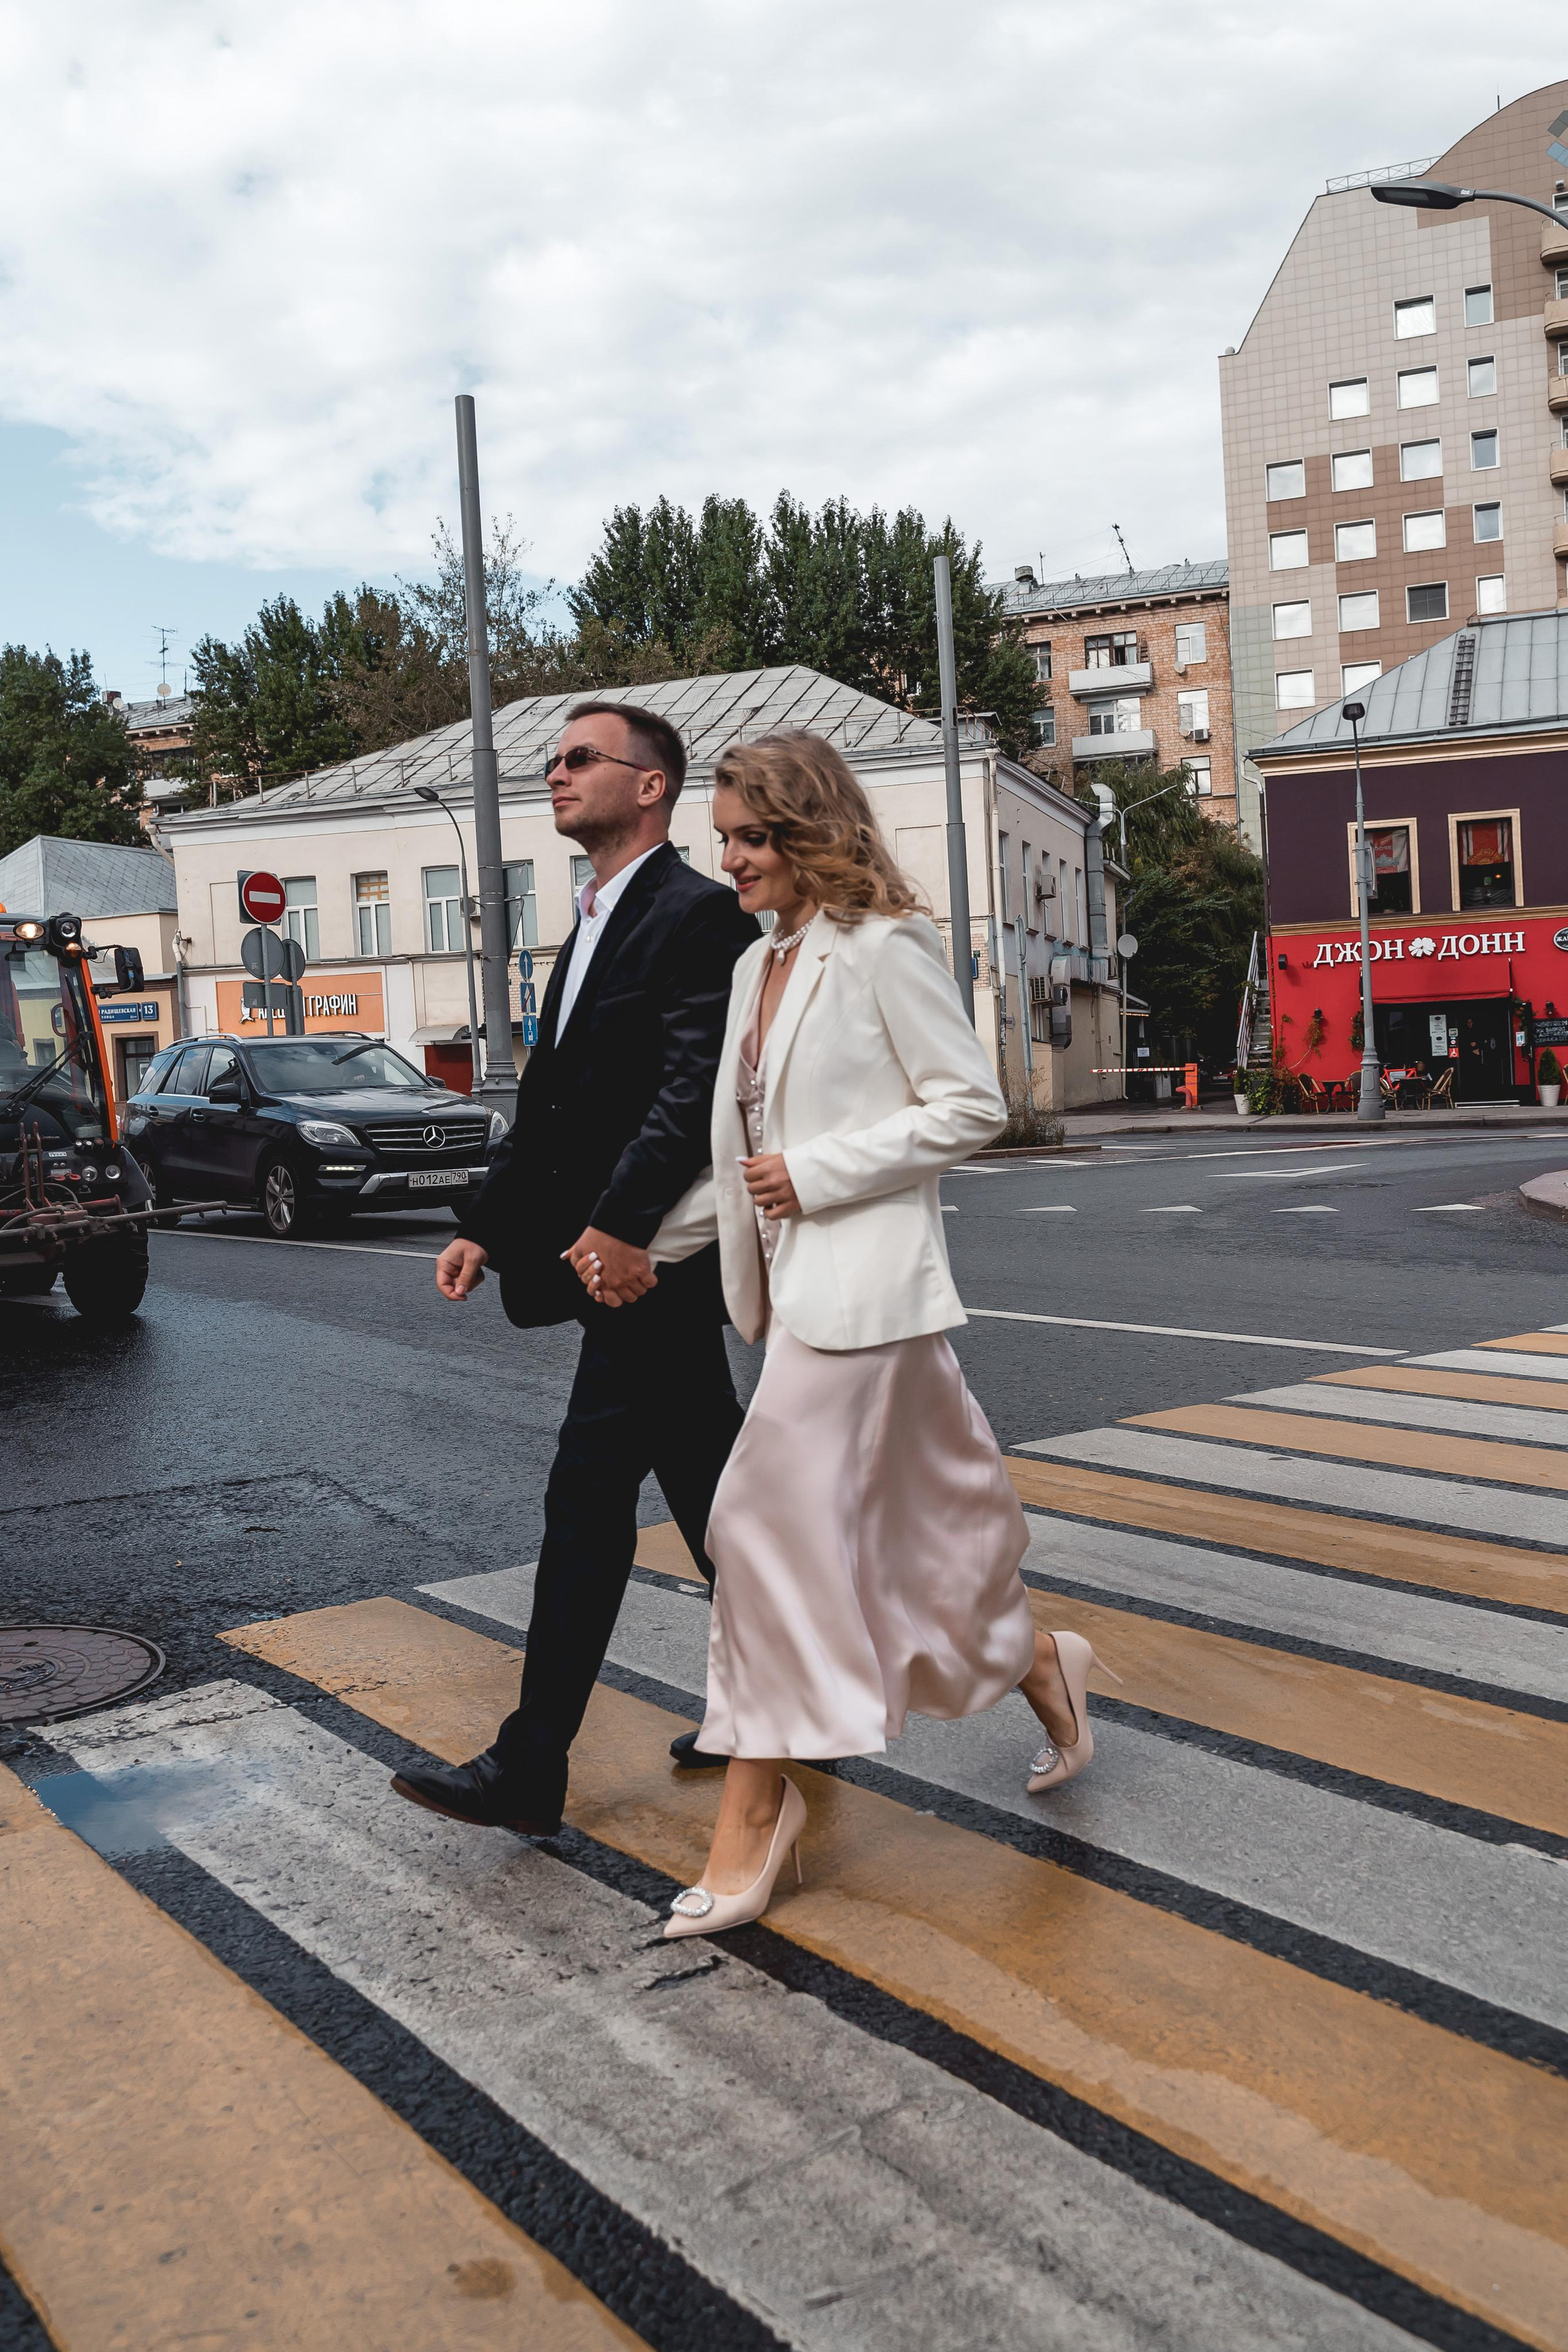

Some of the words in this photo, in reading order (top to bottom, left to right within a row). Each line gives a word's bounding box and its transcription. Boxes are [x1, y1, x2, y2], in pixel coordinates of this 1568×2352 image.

[1313, 938, 1404, 968] ДЖОН
[1438, 932, 1526, 960] ДОНН
[144, 1005, 153, 1014] 13
[309, 993, 357, 1017] ГРАФИН
